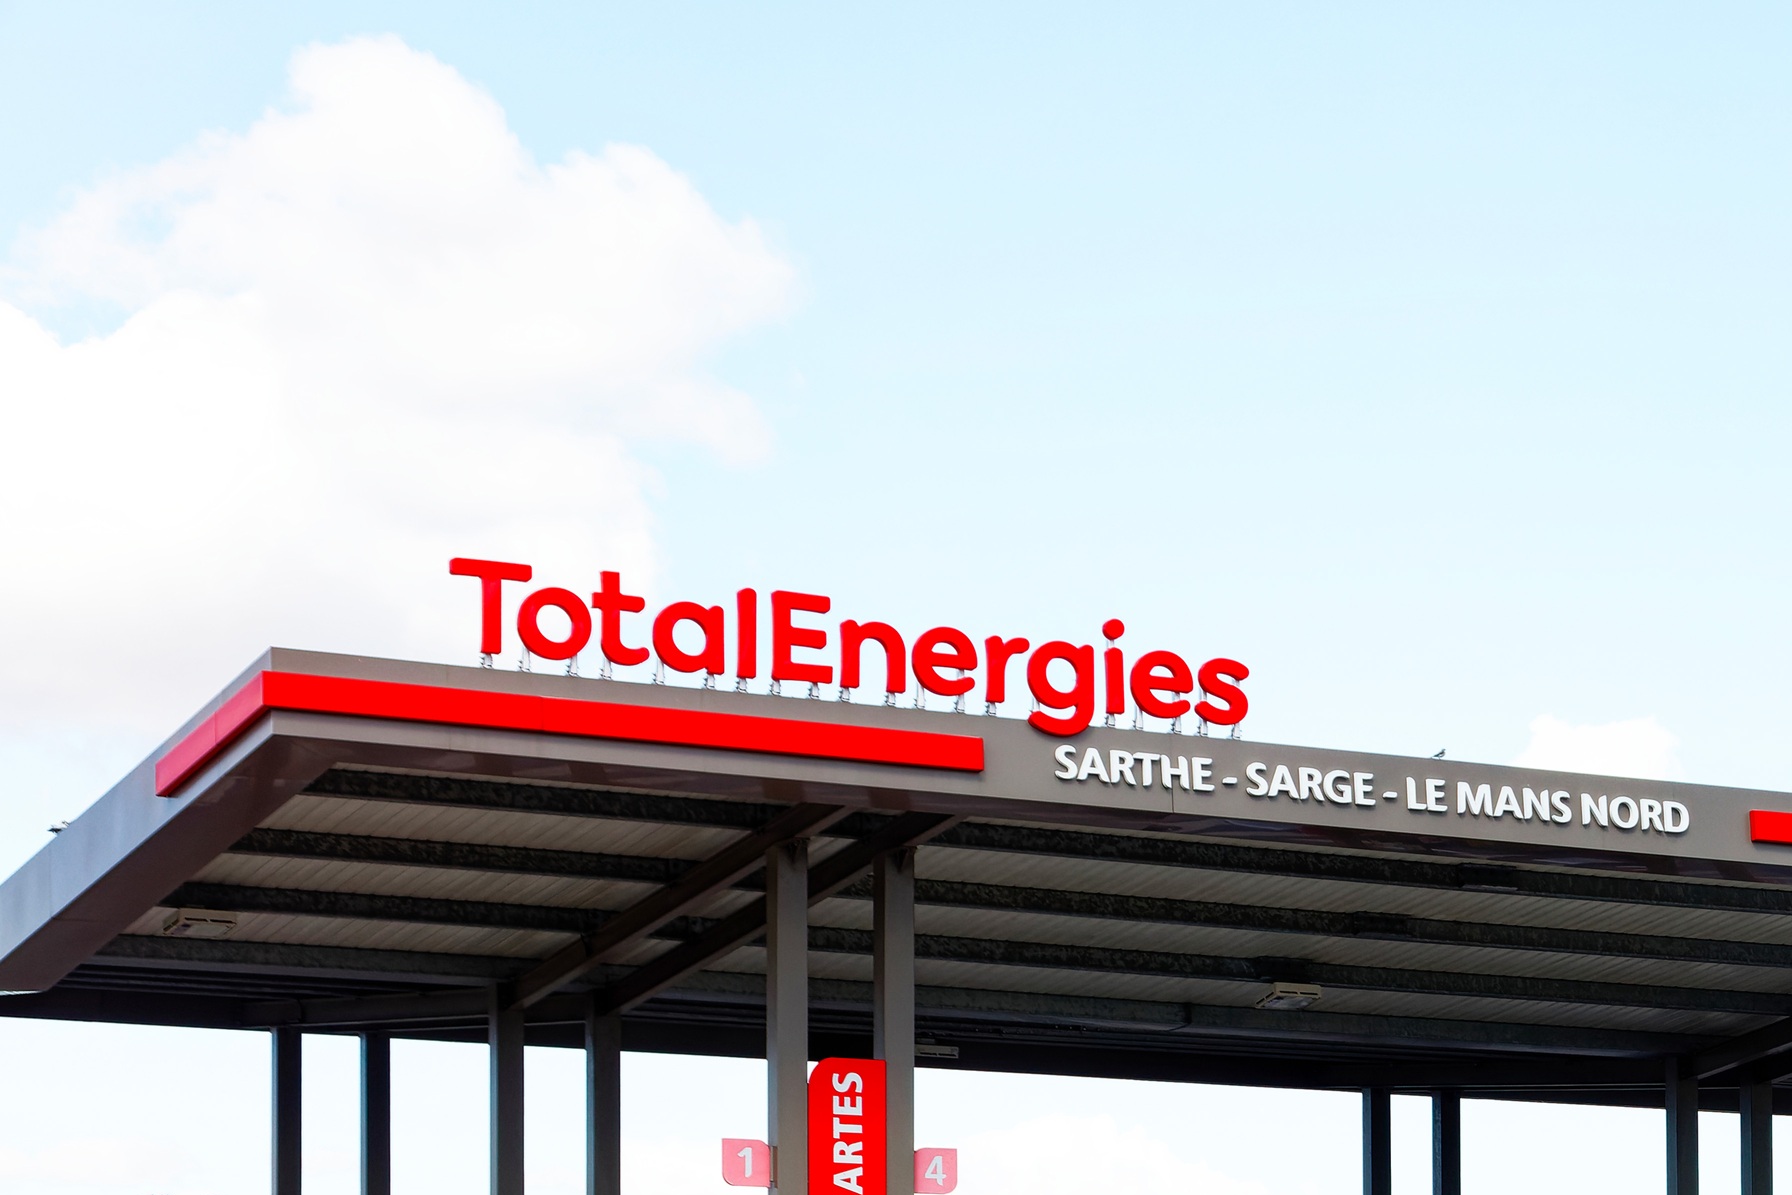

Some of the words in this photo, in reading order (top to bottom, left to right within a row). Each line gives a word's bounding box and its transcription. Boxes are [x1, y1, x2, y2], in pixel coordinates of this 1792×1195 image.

[449, 557, 1250, 736] TotalEnergies
[1054, 744, 1213, 793] SARTHE
[1246, 761, 1376, 806] SARGE
[1406, 776, 1448, 813] LE
[1457, 781, 1572, 826] MANS
[1581, 794, 1691, 834] NORD
[738, 1147, 754, 1178] 1
[924, 1155, 948, 1187] 4
